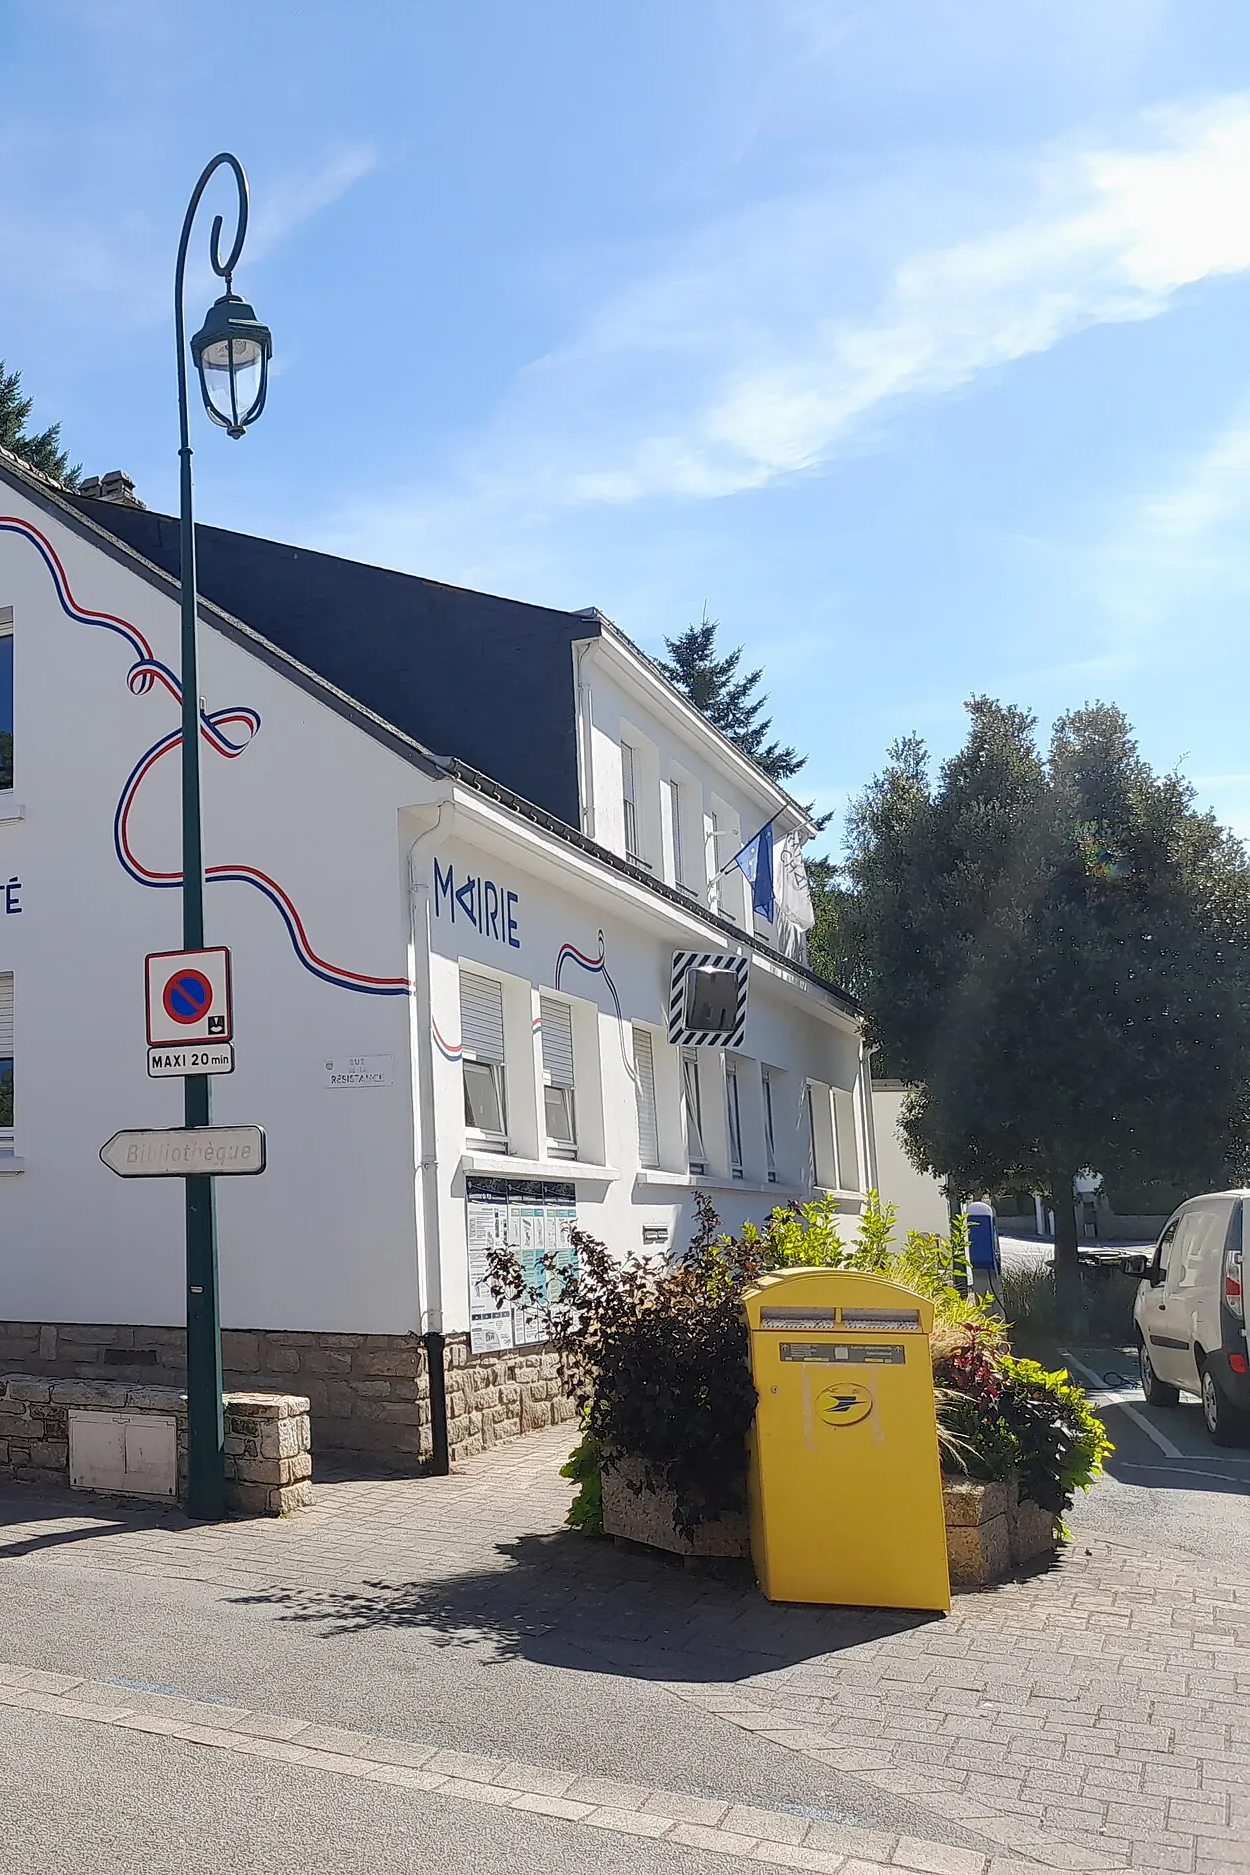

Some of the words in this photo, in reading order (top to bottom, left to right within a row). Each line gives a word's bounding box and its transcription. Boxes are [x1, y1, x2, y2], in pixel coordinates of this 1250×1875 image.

[433, 856, 521, 949] MAIRIE
[151, 1054, 187, 1069] MAXI
[191, 1052, 209, 1067] 20
[211, 1054, 230, 1066] min
[126, 1141, 253, 1166] Bibliothèque
